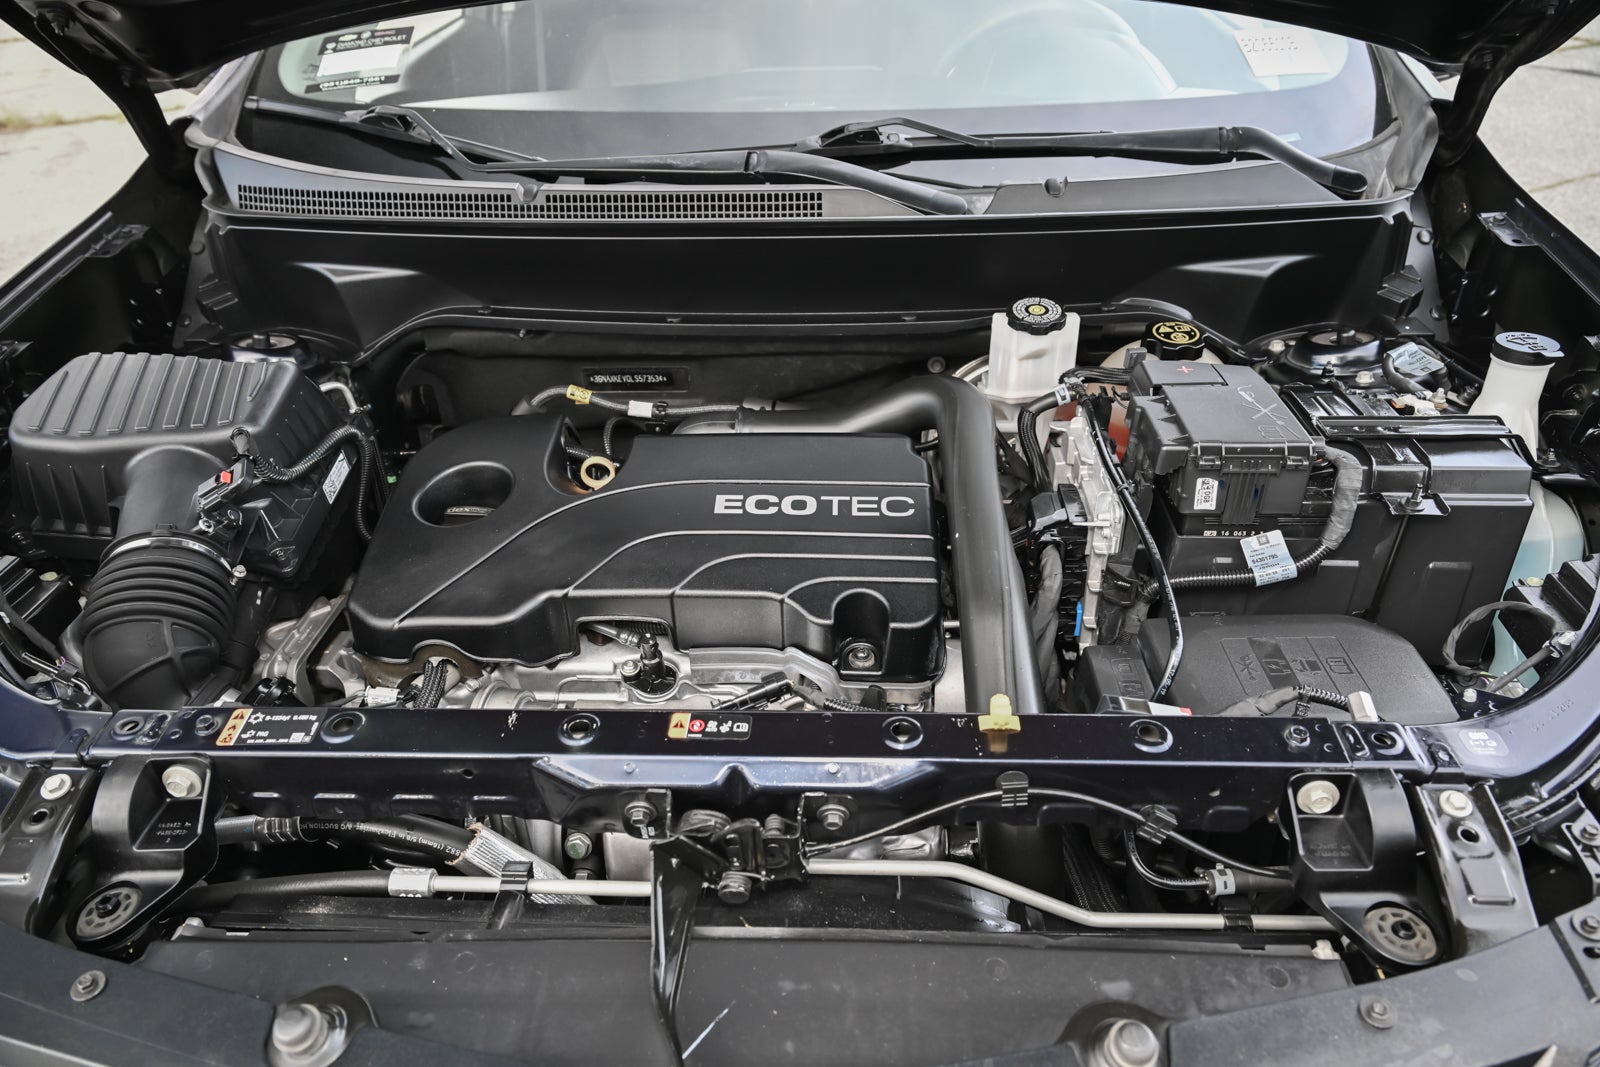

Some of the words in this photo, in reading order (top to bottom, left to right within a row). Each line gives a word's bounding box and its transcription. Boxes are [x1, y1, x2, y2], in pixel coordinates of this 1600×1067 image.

[713, 494, 915, 517] ECOTEC
[308, 822, 339, 831] SUCTION
[406, 833, 417, 843] 5/8
[418, 835, 445, 851] (16mm)
